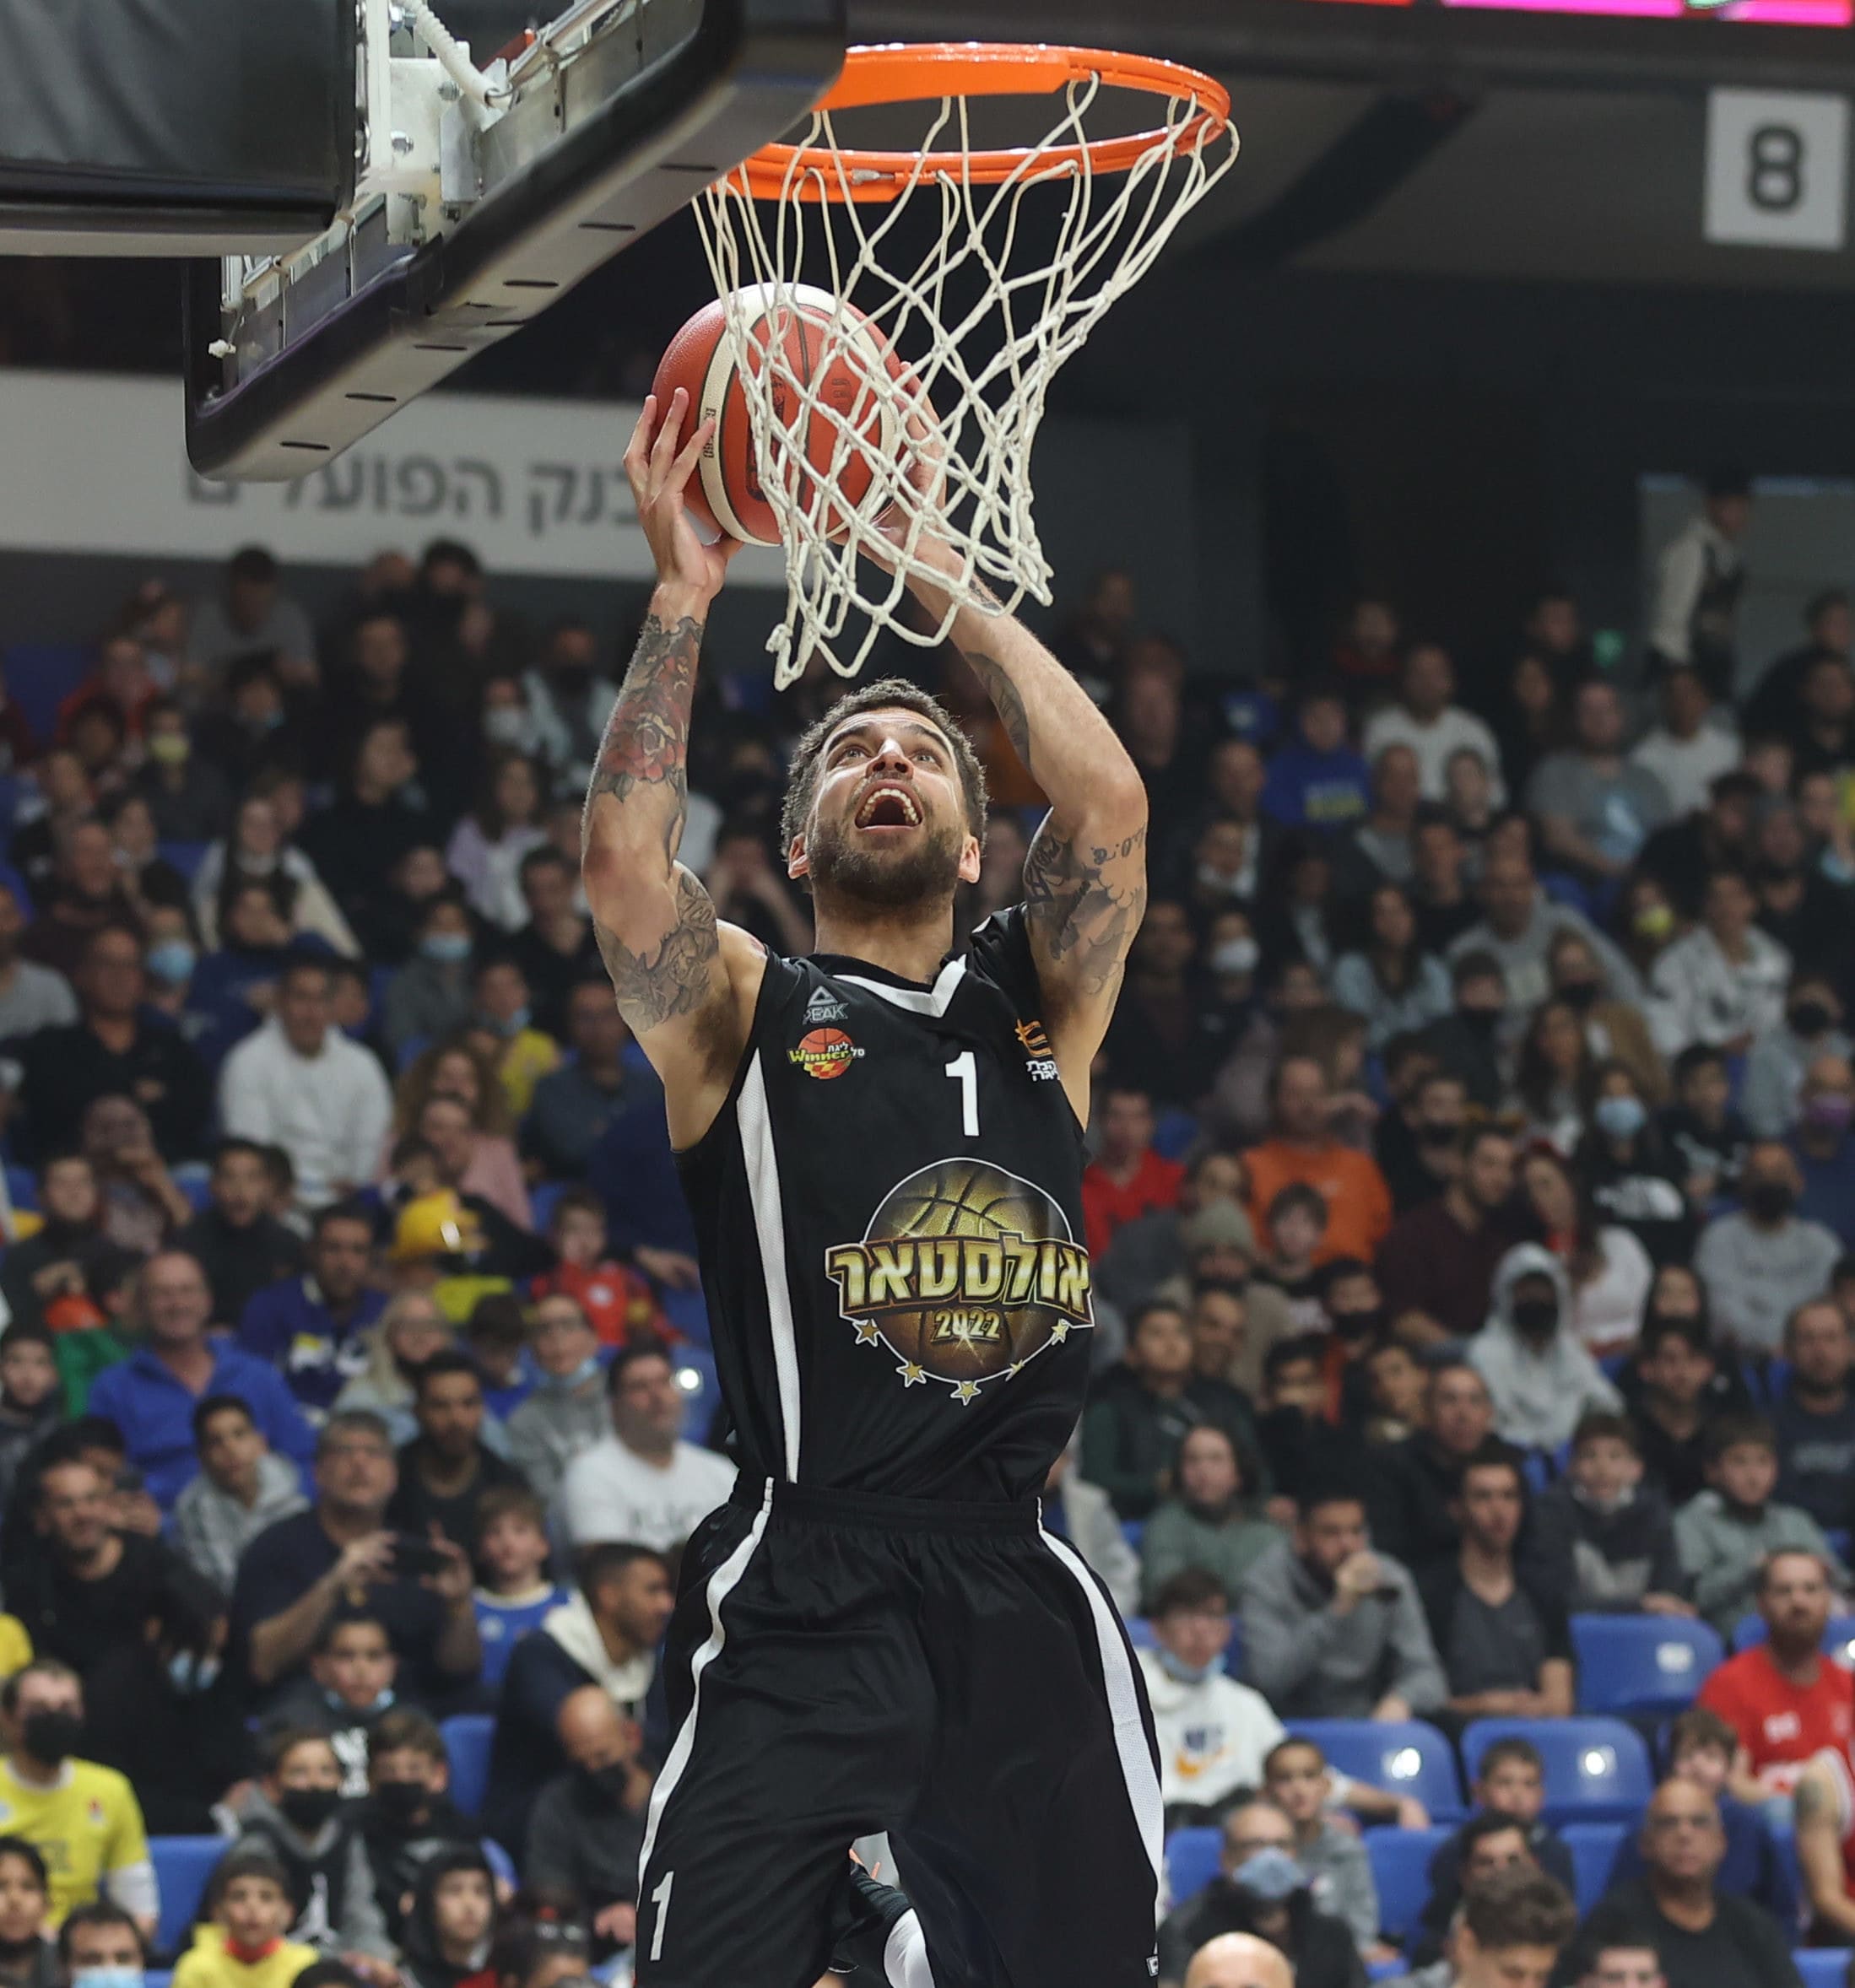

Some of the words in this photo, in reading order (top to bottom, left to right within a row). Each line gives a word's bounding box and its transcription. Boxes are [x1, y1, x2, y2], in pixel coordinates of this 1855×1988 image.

[1748, 124, 1804, 213] 8
[187, 451, 505, 518] הפוע
[789, 1049, 849, 1062] Winner
[945, 1051, 980, 1137] 1
[832, 1237, 1090, 1314] אולסטאר
[934, 1309, 1001, 1338] 2022
[650, 1871, 674, 1961] 1
